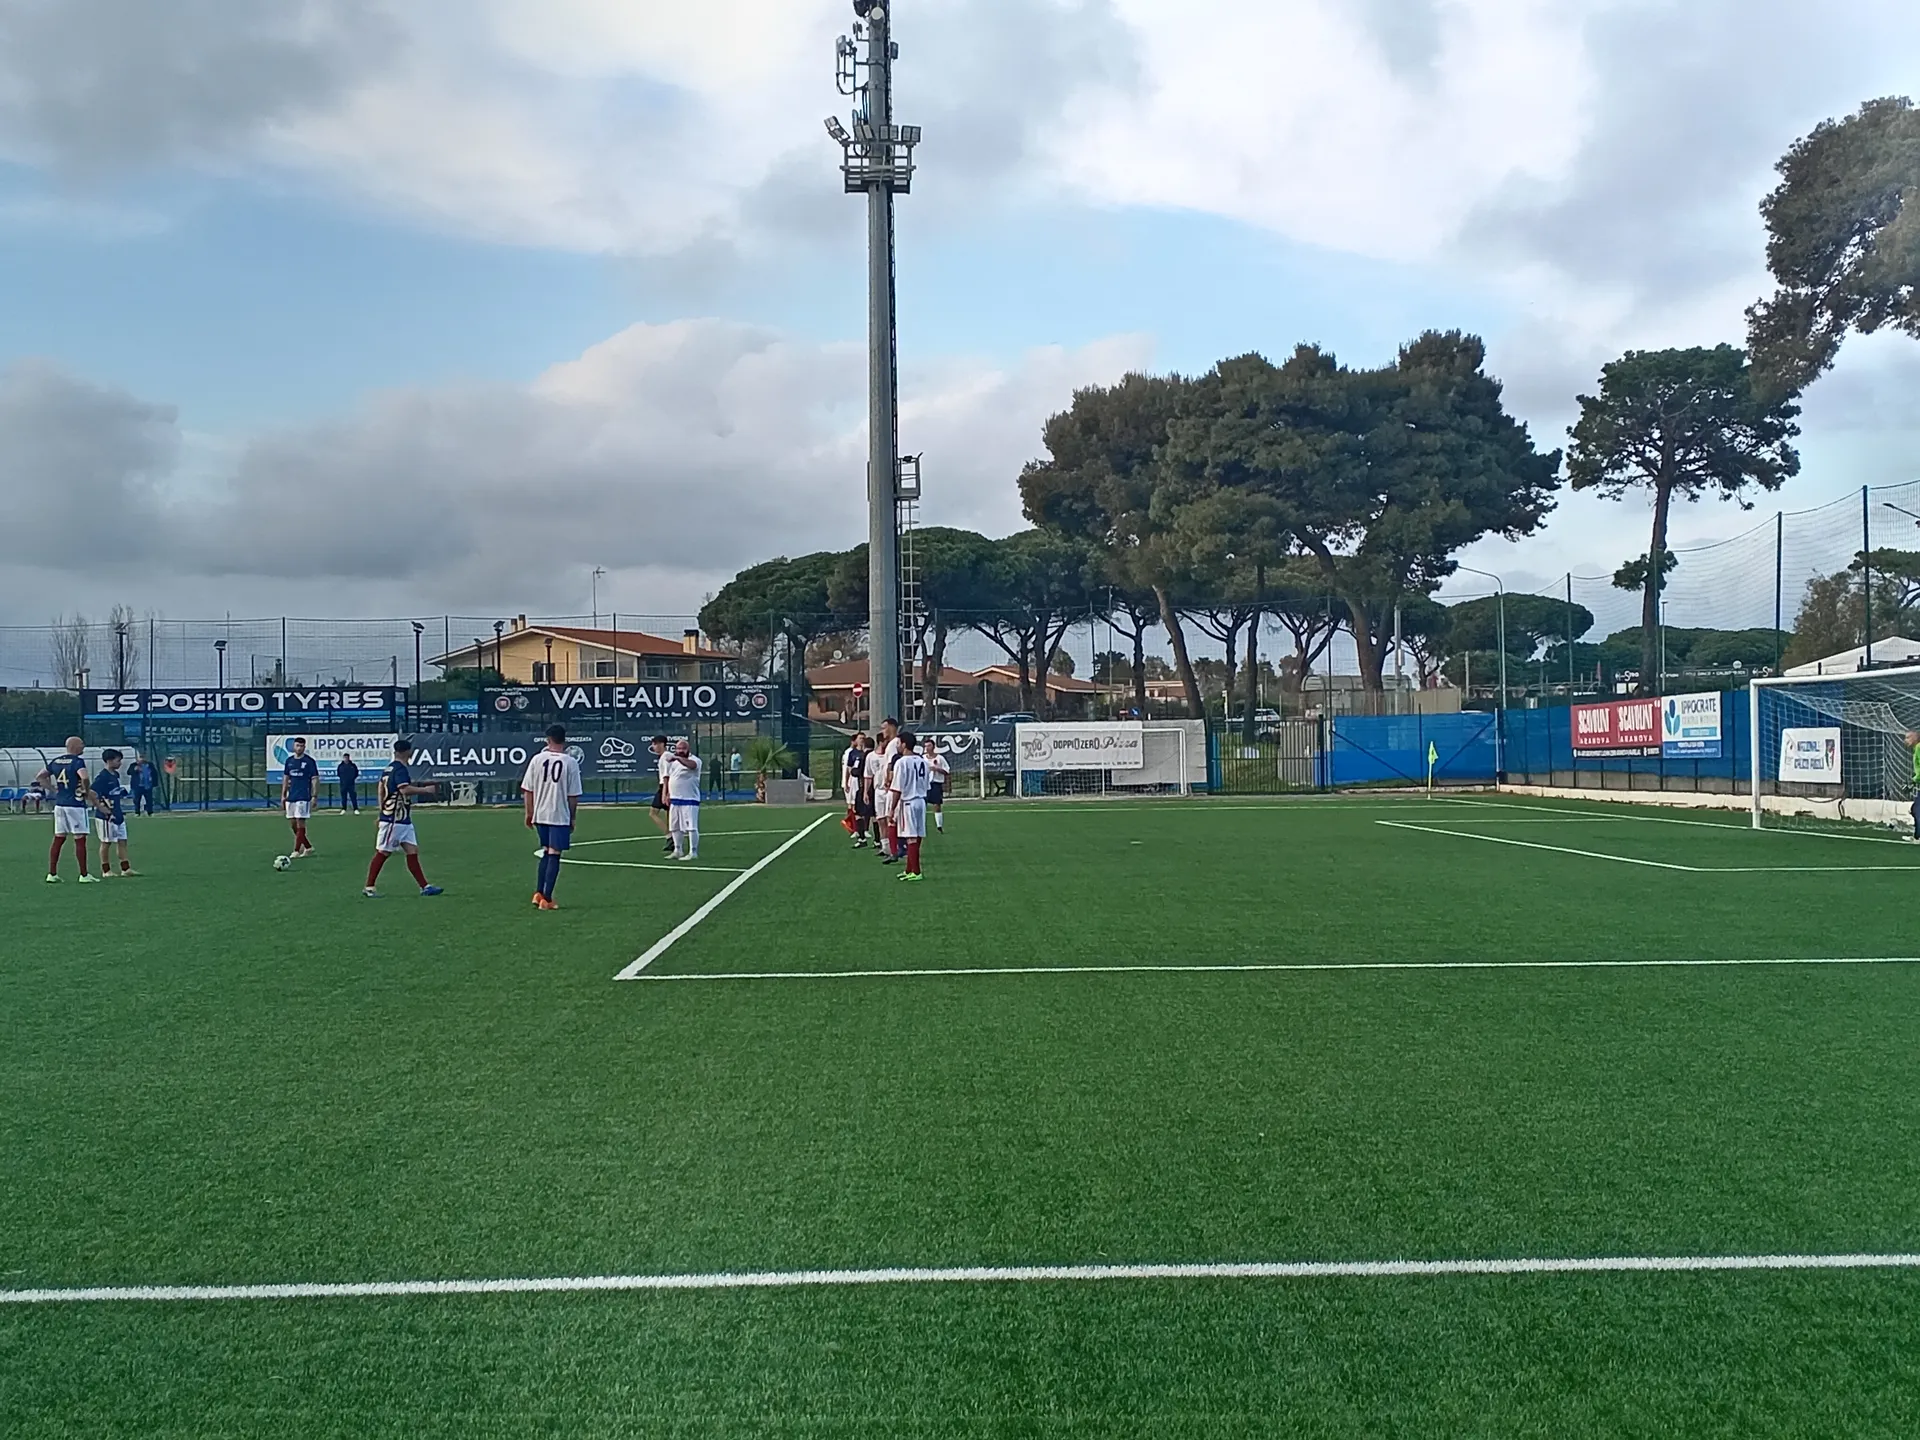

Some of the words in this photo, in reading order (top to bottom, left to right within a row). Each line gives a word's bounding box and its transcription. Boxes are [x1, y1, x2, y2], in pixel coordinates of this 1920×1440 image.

[272, 690, 385, 710] TYRES
[550, 685, 717, 709] VALEAUTO
[313, 737, 391, 750] IPPOCRATE
[1100, 736, 1138, 750] Pizza
[1579, 736, 1610, 745] ARANOVA
[1619, 734, 1654, 743] ARANOVA
[407, 747, 527, 766] VALEAUTO
[57, 768, 69, 789] 4
[543, 758, 563, 783] 10
[914, 761, 926, 781] 14
